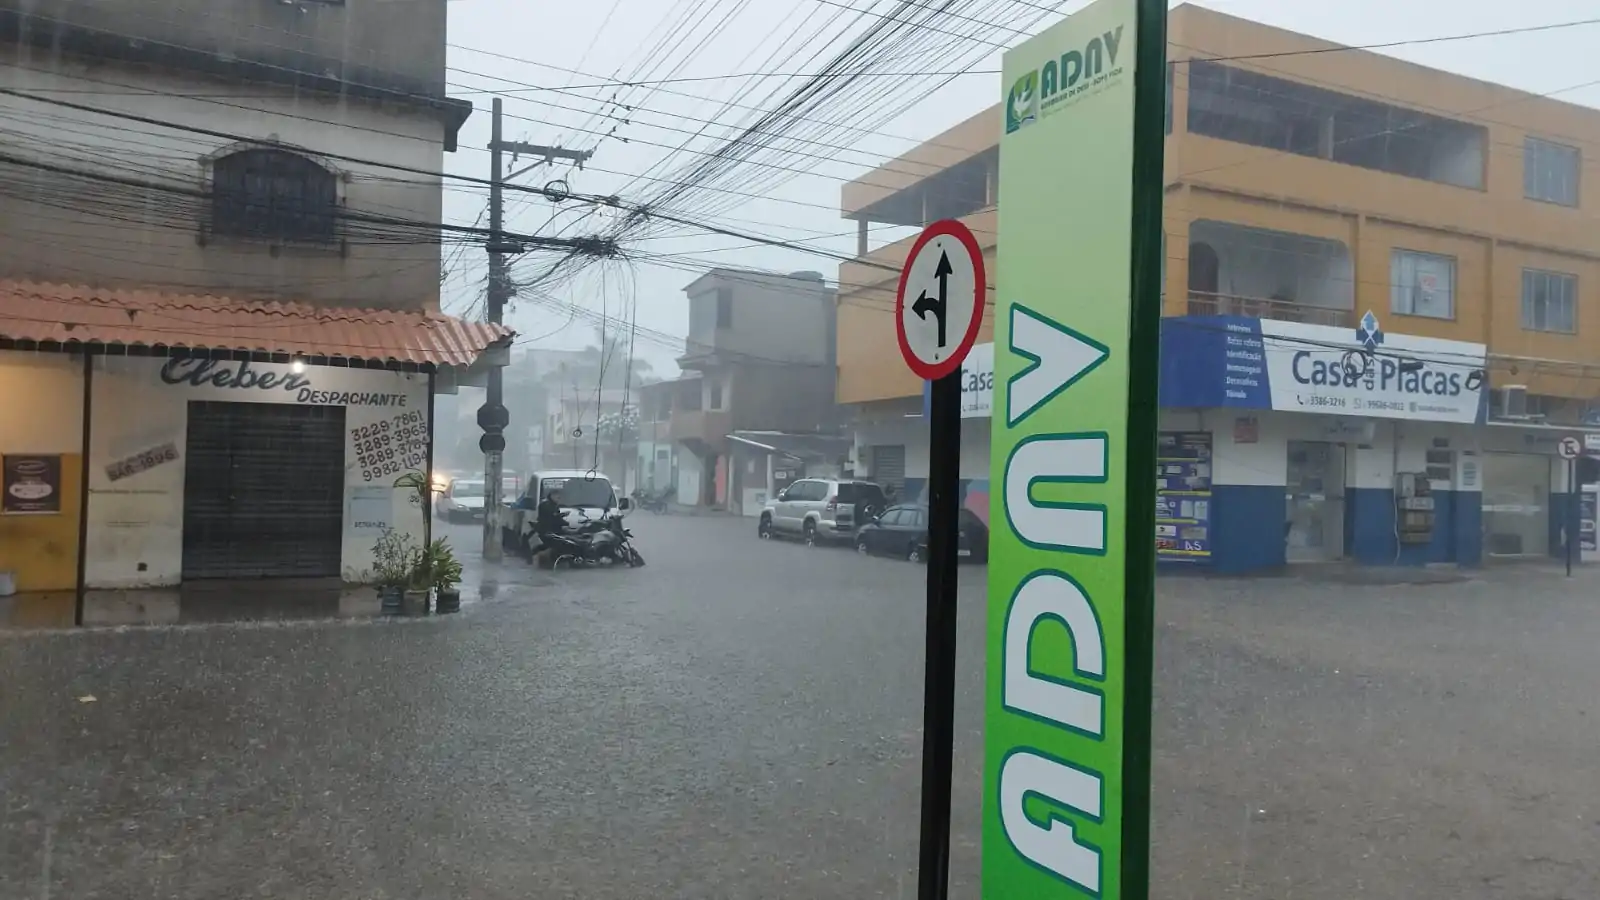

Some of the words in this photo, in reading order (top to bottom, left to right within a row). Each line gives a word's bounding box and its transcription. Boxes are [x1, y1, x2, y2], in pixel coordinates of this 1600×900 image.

[1041, 23, 1124, 100] ADNV
[160, 357, 312, 391] Cleber
[1292, 351, 1358, 388] Casa
[1381, 358, 1461, 396] Placas
[297, 388, 407, 407] DESPACHANTE
[351, 410, 423, 441] 3229-7861
[354, 422, 427, 455] 3289-3965
[999, 302, 1110, 892] ADNV
